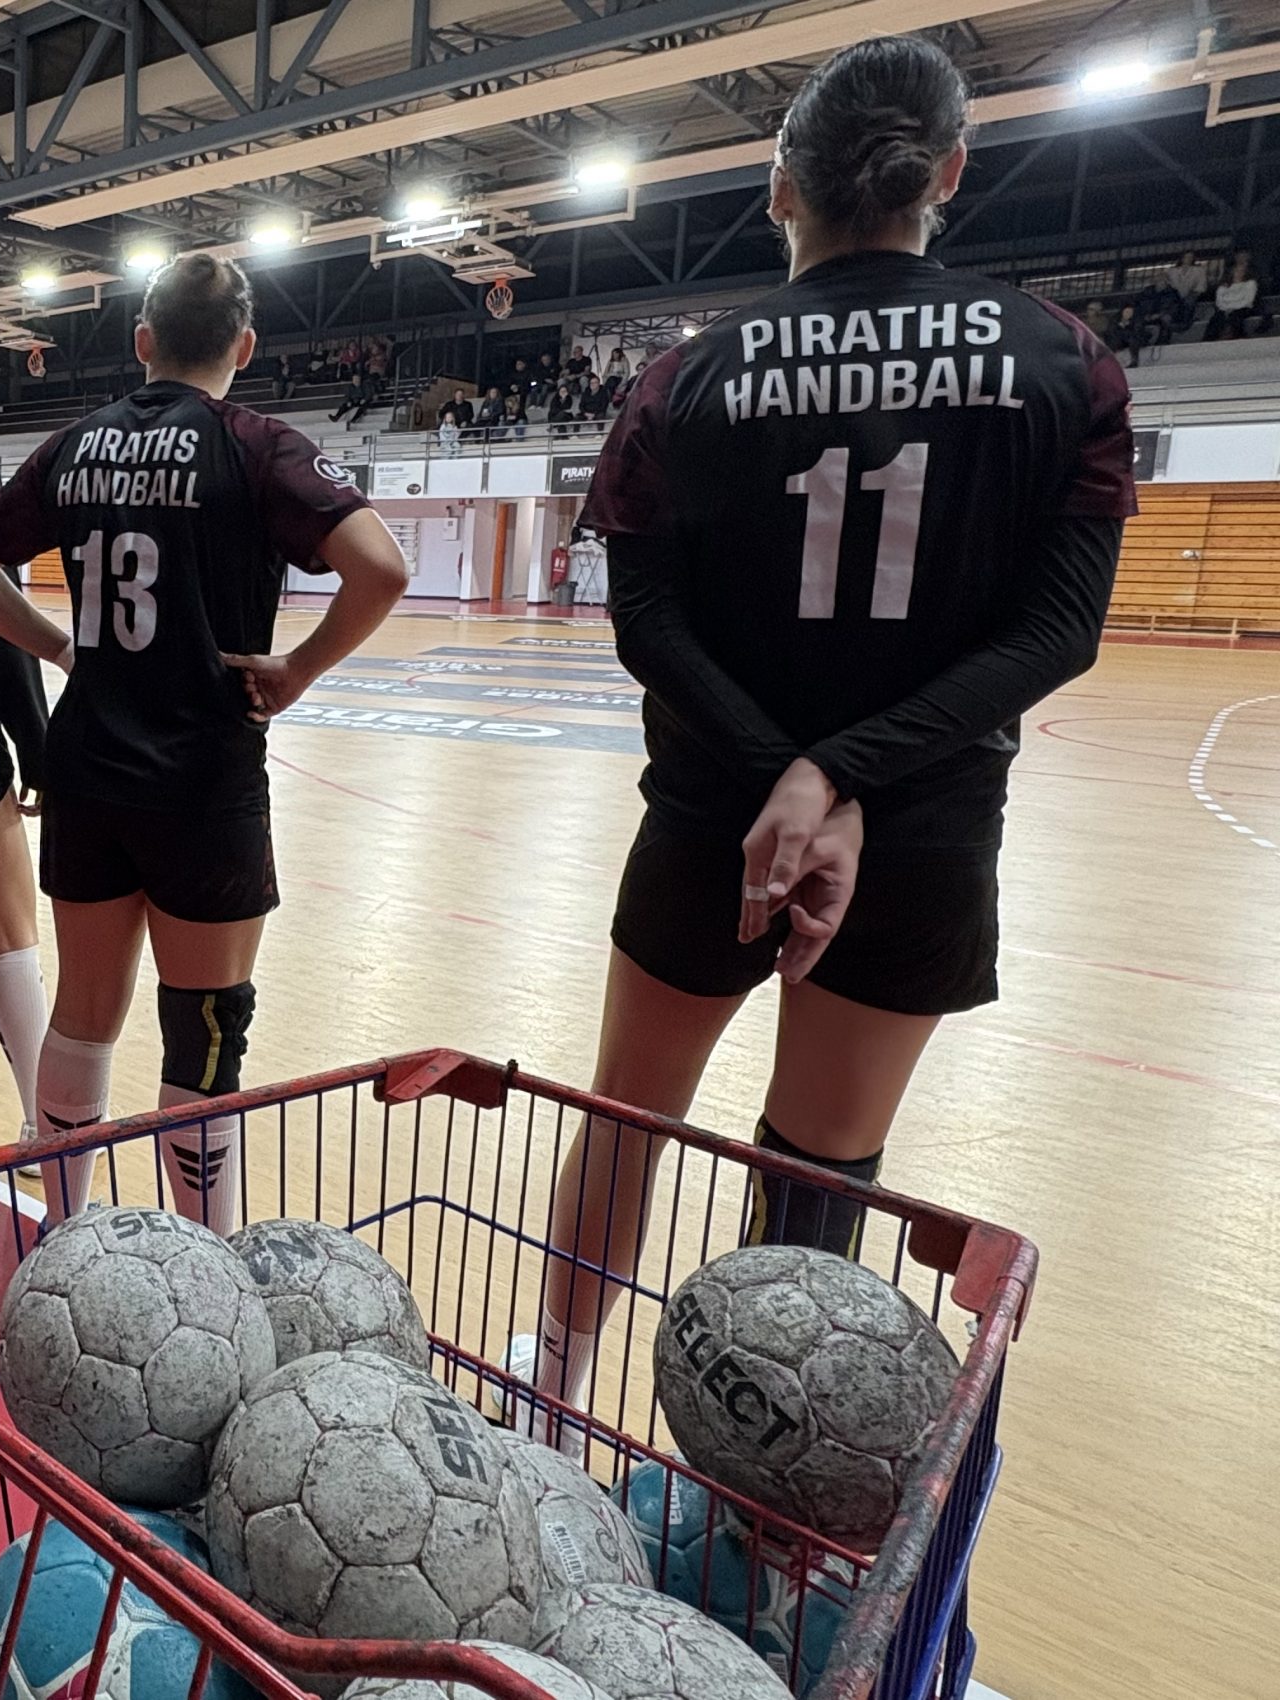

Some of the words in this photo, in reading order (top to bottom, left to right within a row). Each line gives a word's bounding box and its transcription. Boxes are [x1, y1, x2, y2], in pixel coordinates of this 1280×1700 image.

[740, 299, 1004, 364] PIRATHS
[723, 355, 1025, 425] HANDBALL
[74, 426, 200, 464] PIRATHS
[561, 466, 596, 481] PIRATH
[57, 466, 201, 508] HANDBALL
[786, 442, 929, 620] 11
[72, 529, 159, 652] 13
[669, 1292, 801, 1450] SELECT
